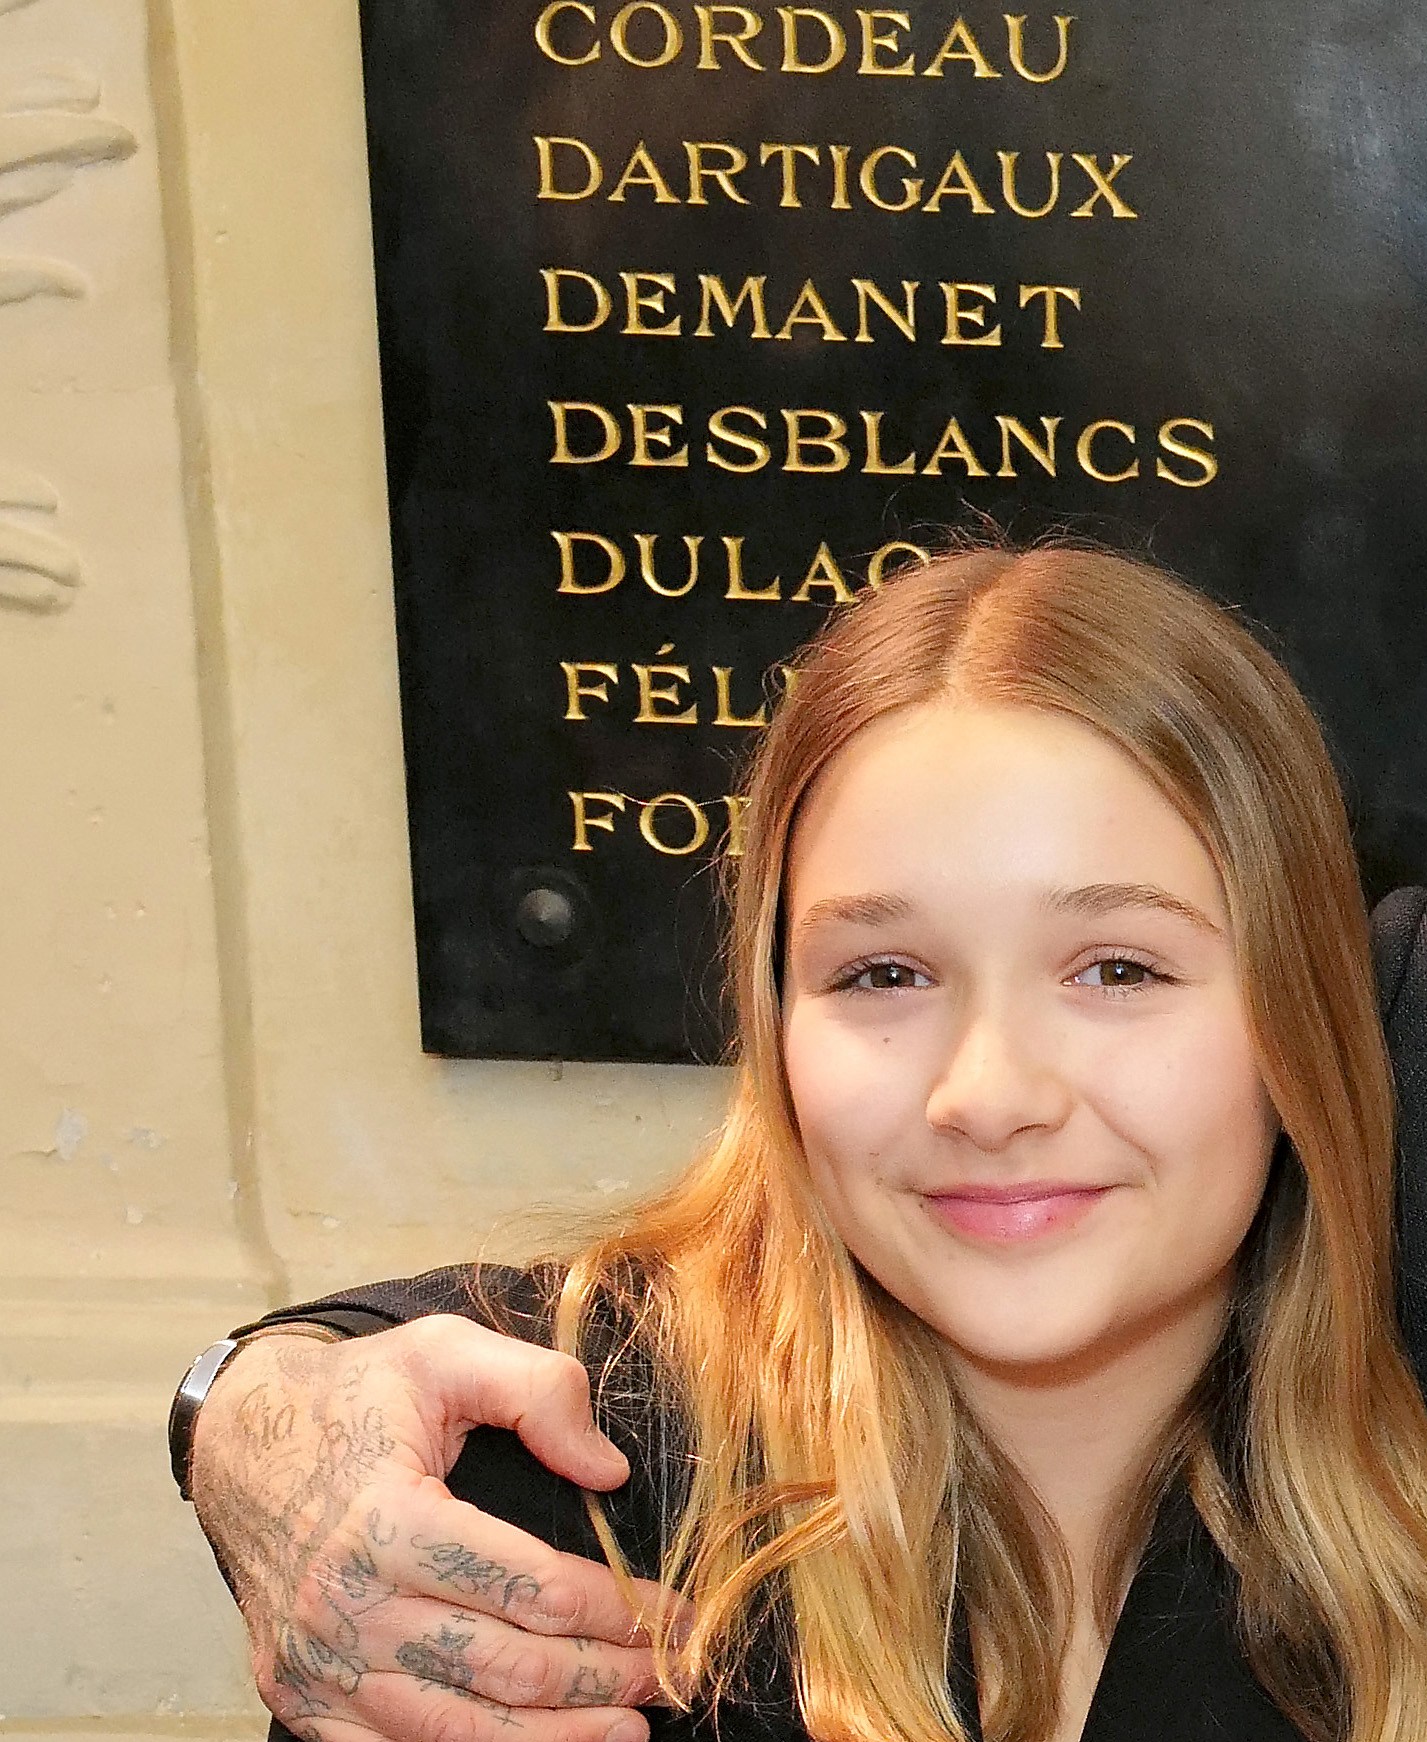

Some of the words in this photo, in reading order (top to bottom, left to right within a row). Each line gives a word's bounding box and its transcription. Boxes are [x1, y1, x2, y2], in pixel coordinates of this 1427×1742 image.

[533, 0, 1071, 84] CORDEAU
[534, 135, 1138, 221] DARTIGAUX
[542, 267, 1083, 349] DEMANET
[548, 400, 1220, 488] DESBLANCS
